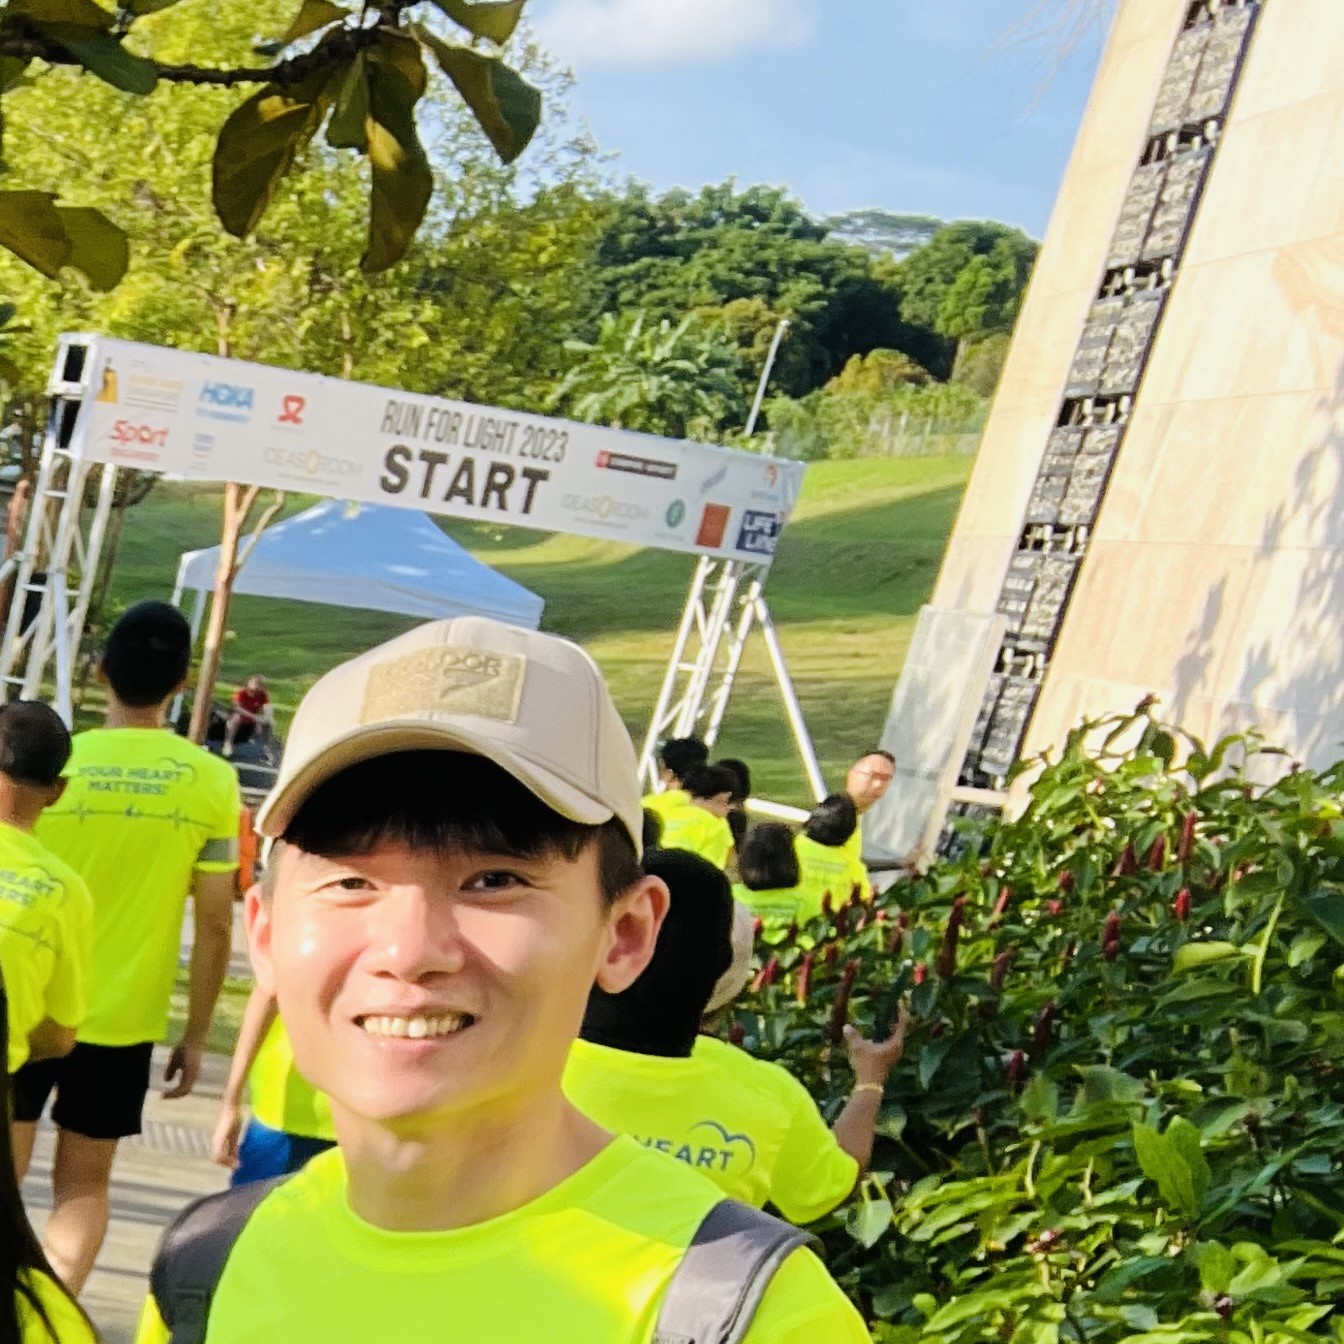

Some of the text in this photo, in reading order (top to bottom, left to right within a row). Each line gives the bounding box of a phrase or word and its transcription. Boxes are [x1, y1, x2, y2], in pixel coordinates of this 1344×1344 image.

[380, 398, 570, 463] RUN FOR LIGHT 2023
[380, 444, 551, 514] START
